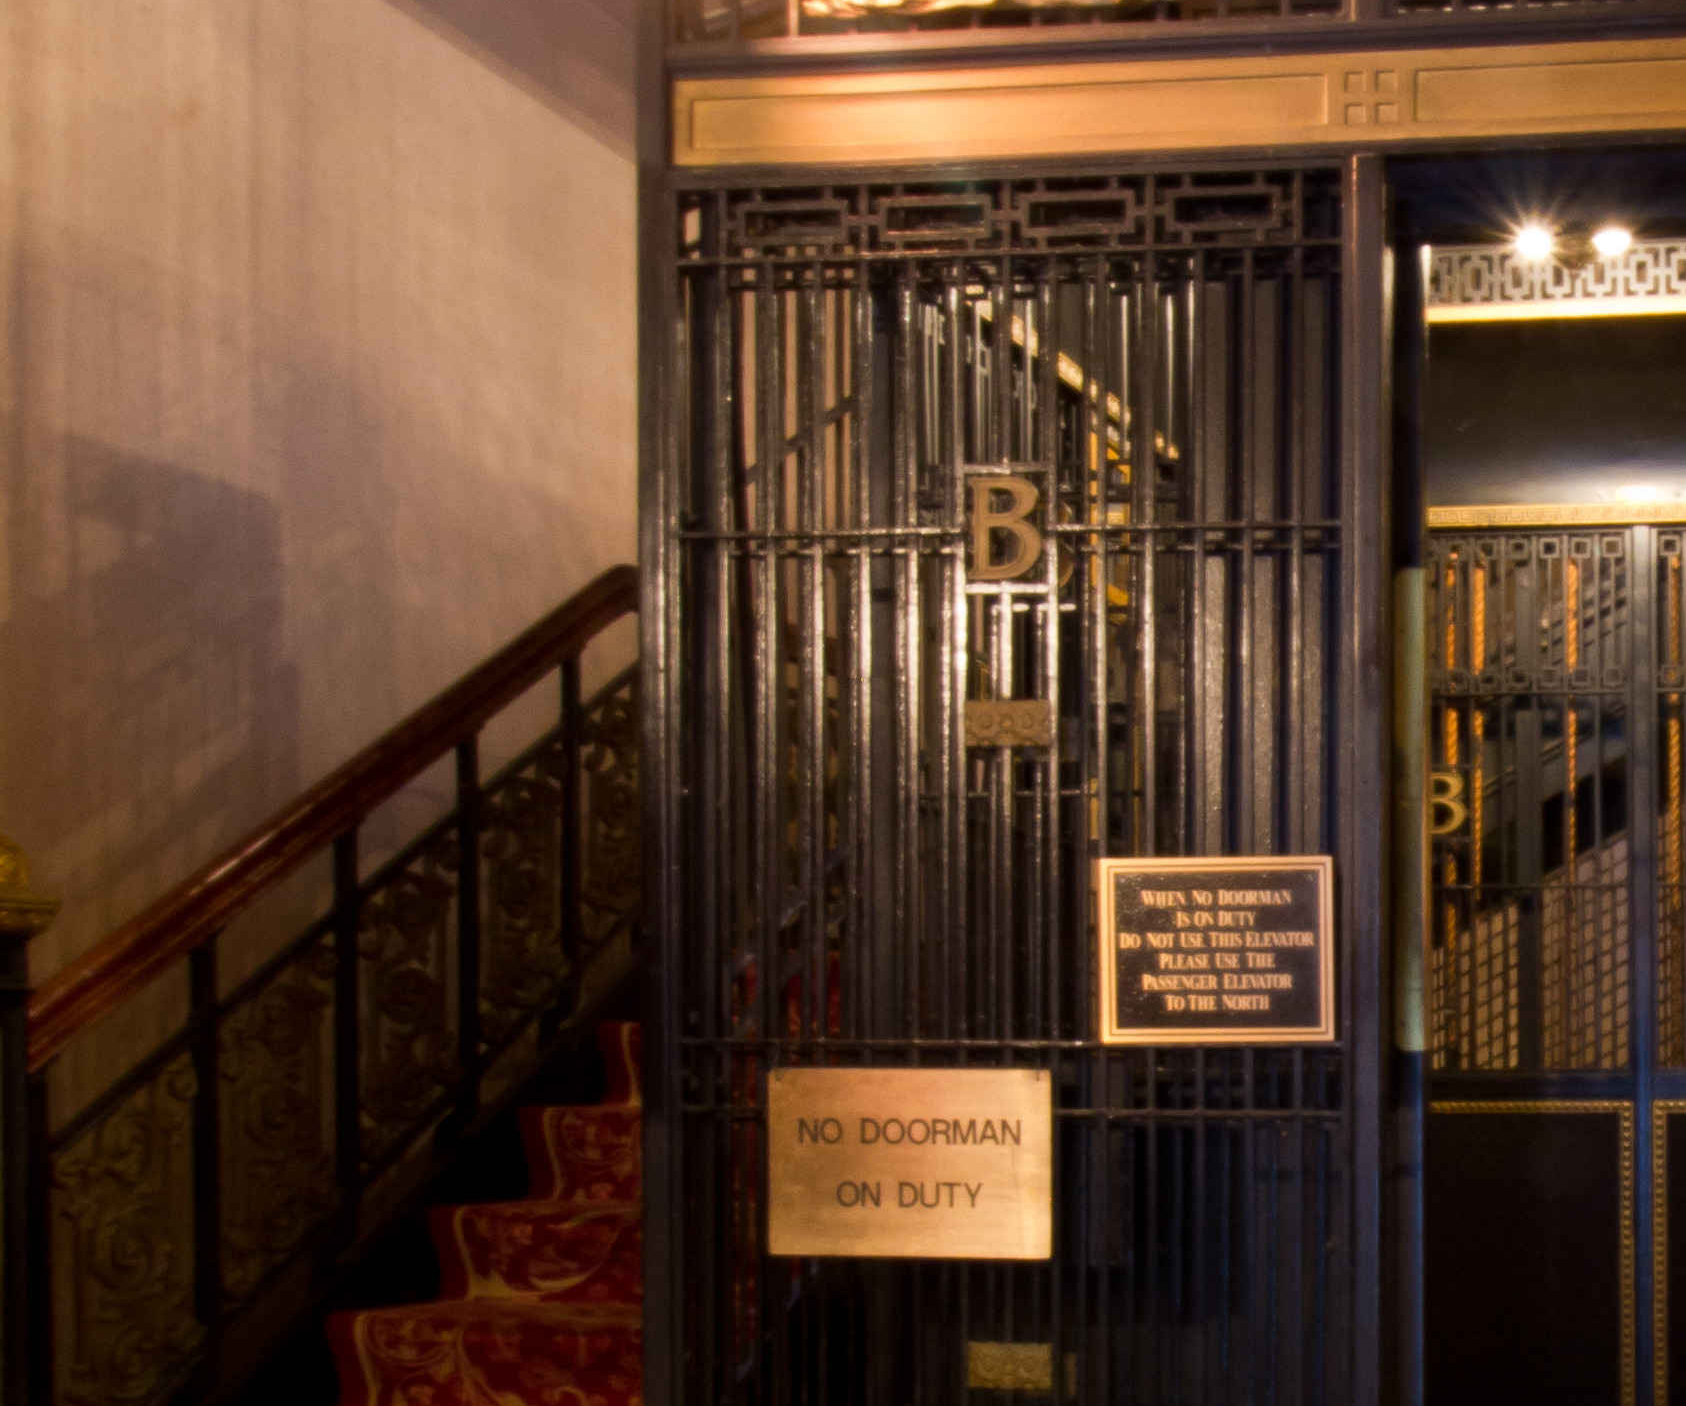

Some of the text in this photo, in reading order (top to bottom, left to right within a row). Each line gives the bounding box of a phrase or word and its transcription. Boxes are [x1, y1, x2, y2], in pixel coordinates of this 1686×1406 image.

[969, 476, 1041, 580] B
[1141, 889, 1292, 906] WHEN NO DOORMAN
[1176, 911, 1256, 928] IS ON DUTY
[1120, 931, 1314, 949] DO NOT USE THIS ELEVATOR
[1160, 953, 1275, 969] PLEASE USE THE
[1142, 974, 1292, 990] PASSENGER ELEVATOR
[1165, 995, 1270, 1011] TO THE NORTH
[798, 1118, 1021, 1146] NO DOORMAN
[836, 1181, 983, 1208] ON DUTY
